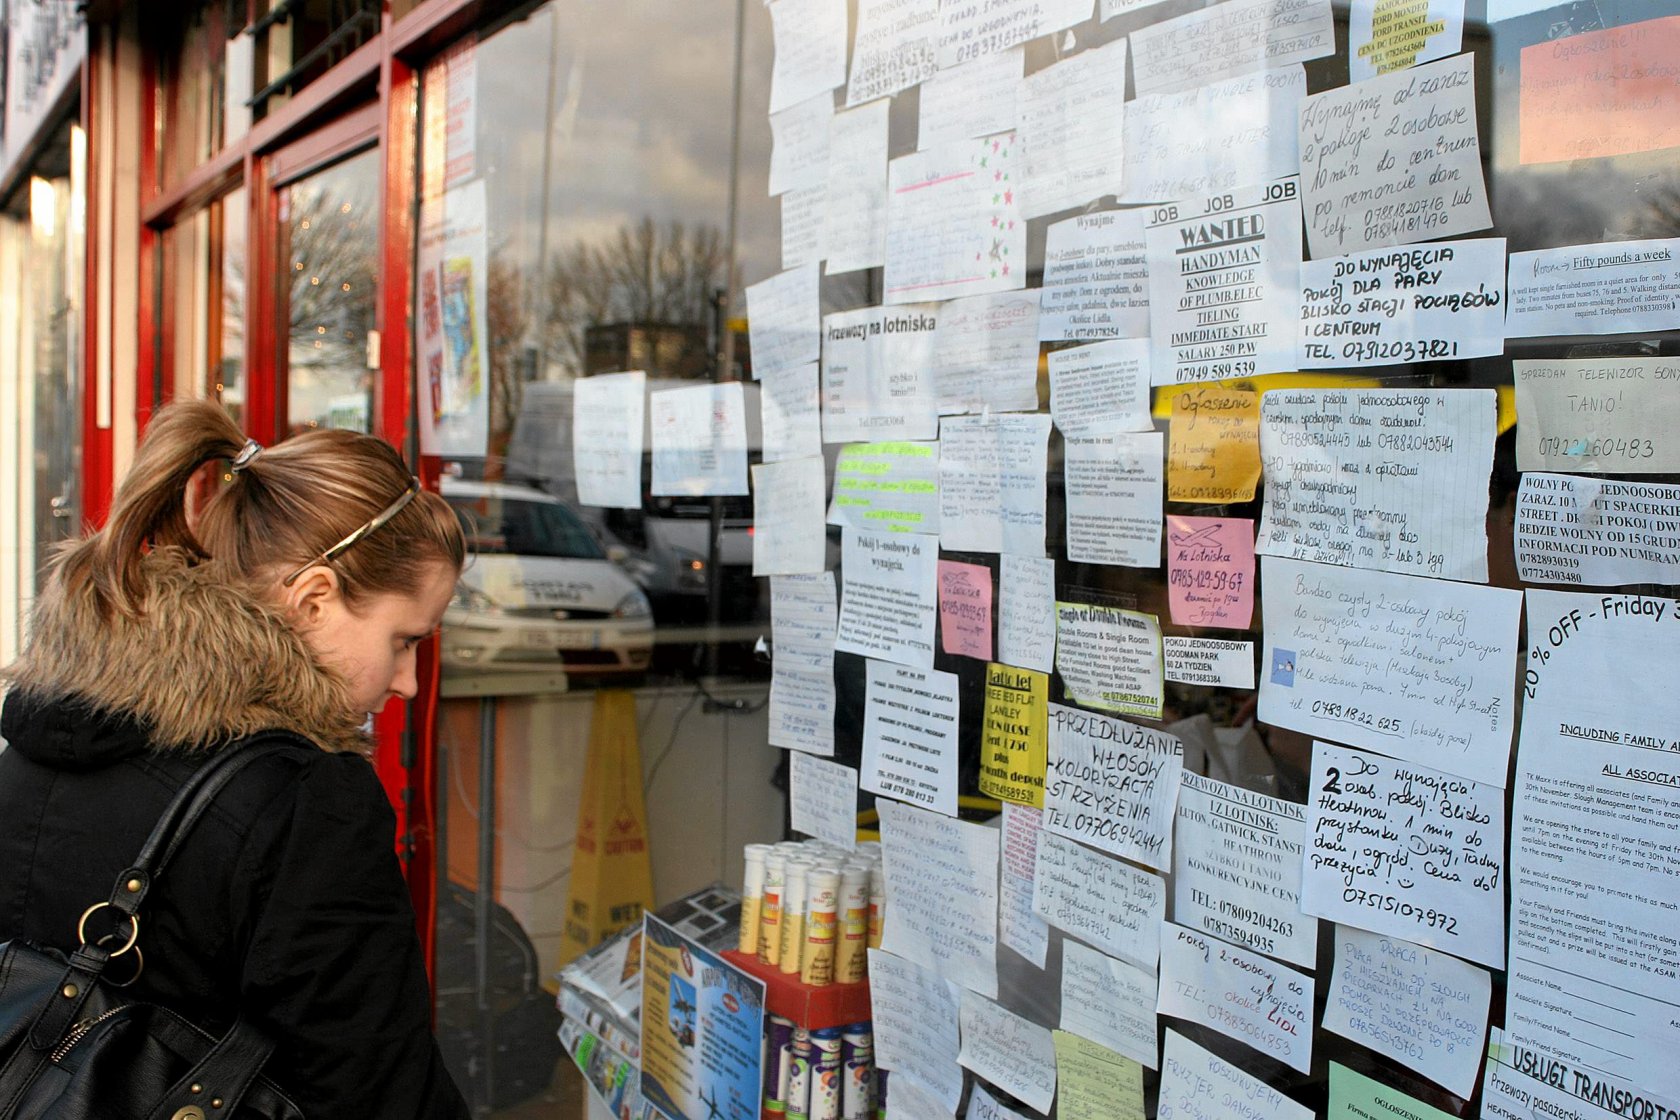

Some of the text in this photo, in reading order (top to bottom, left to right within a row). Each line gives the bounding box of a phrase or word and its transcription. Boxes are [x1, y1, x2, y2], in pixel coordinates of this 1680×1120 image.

[1373, 2, 1428, 27] FORD MONDEO
[1373, 15, 1426, 39] FORD TRANSIT
[1377, 150, 1395, 173] do
[1429, 164, 1461, 185] dom
[1262, 182, 1296, 201] JOB
[1452, 187, 1472, 207] lub
[1204, 195, 1234, 213] JOB
[1151, 207, 1179, 224] JOB
[1181, 212, 1264, 248] WANTED
[1181, 246, 1261, 273] HANDYMAN
[1335, 248, 1453, 278] DO WYNAJĘCIA
[1573, 248, 1671, 269] Fifty pounds week
[1186, 269, 1255, 290] KNOWLEDGE
[1304, 270, 1442, 302] POKÓJ DLA PARY
[1652, 273, 1666, 283] only
[1630, 285, 1656, 295] Walking
[1645, 292, 1669, 303] identity
[1180, 296, 1195, 309] OF
[1301, 301, 1351, 319] BLISKO
[1357, 298, 1404, 318] STACJI
[1600, 304, 1631, 316] Telephone
[883, 313, 935, 333] lotniska
[1197, 308, 1239, 324] TIELING
[1171, 322, 1268, 344] IMMEDIATE START
[1313, 322, 1380, 337] CENTRUM
[1178, 342, 1257, 361] SALARY 250 P.W
[1305, 340, 1458, 361] TEL. 07912037821
[1176, 362, 1255, 382] 07949 589 539
[1521, 367, 1644, 380] SPRZEDAM TELEWIZOR
[1568, 390, 1623, 412] TANIO!
[1526, 478, 1559, 491] WOLNY
[1522, 493, 1569, 507] ZARAZ. 10
[1520, 508, 1647, 529] STREET POKOJ
[1519, 523, 1641, 544] BEDZIE WOLNY OD 15
[1519, 538, 1617, 557] INFORMACJI POD
[1521, 553, 1579, 568] 07828930319
[1522, 568, 1582, 583] 07724303480
[1549, 608, 1582, 647] OFF
[1601, 595, 1665, 622] Friday
[1165, 639, 1248, 651] POKOJ JEDNOOSOBOWY
[1166, 649, 1219, 661] GOODMAN PARK
[1167, 671, 1180, 680] TEL.
[1184, 662, 1212, 671] TYDZIEN
[1559, 723, 1666, 749] INCLUDING FAMILY
[1092, 744, 1164, 780] WŁOSÓW
[1602, 764, 1621, 776] ALL
[1234, 789, 1249, 804] NA
[1596, 798, 1640, 811] Management
[1647, 796, 1669, 807] Family
[1226, 804, 1279, 831] LOTNISK:
[1440, 800, 1490, 824] Blisko
[1423, 824, 1453, 839] min
[1466, 831, 1482, 847] do
[1224, 839, 1283, 863] HEATHROW
[1611, 844, 1632, 856] Friday
[1188, 858, 1269, 894] KONKURENCYJNE
[1424, 861, 1490, 891] Cena do
[1191, 888, 1293, 937] TEL: 07809204263
[1343, 889, 1458, 936] 07515107972
[1203, 915, 1274, 953] 07873594935
[1288, 981, 1303, 996] do
[1545, 980, 1562, 991] Name
[1175, 981, 1206, 1004] TEL:
[1267, 1008, 1298, 1037] LIDL
[1544, 1001, 1573, 1017] Signature
[1513, 1045, 1568, 1090] USŁUGI
[1491, 1074, 1531, 1107] Przewozy
